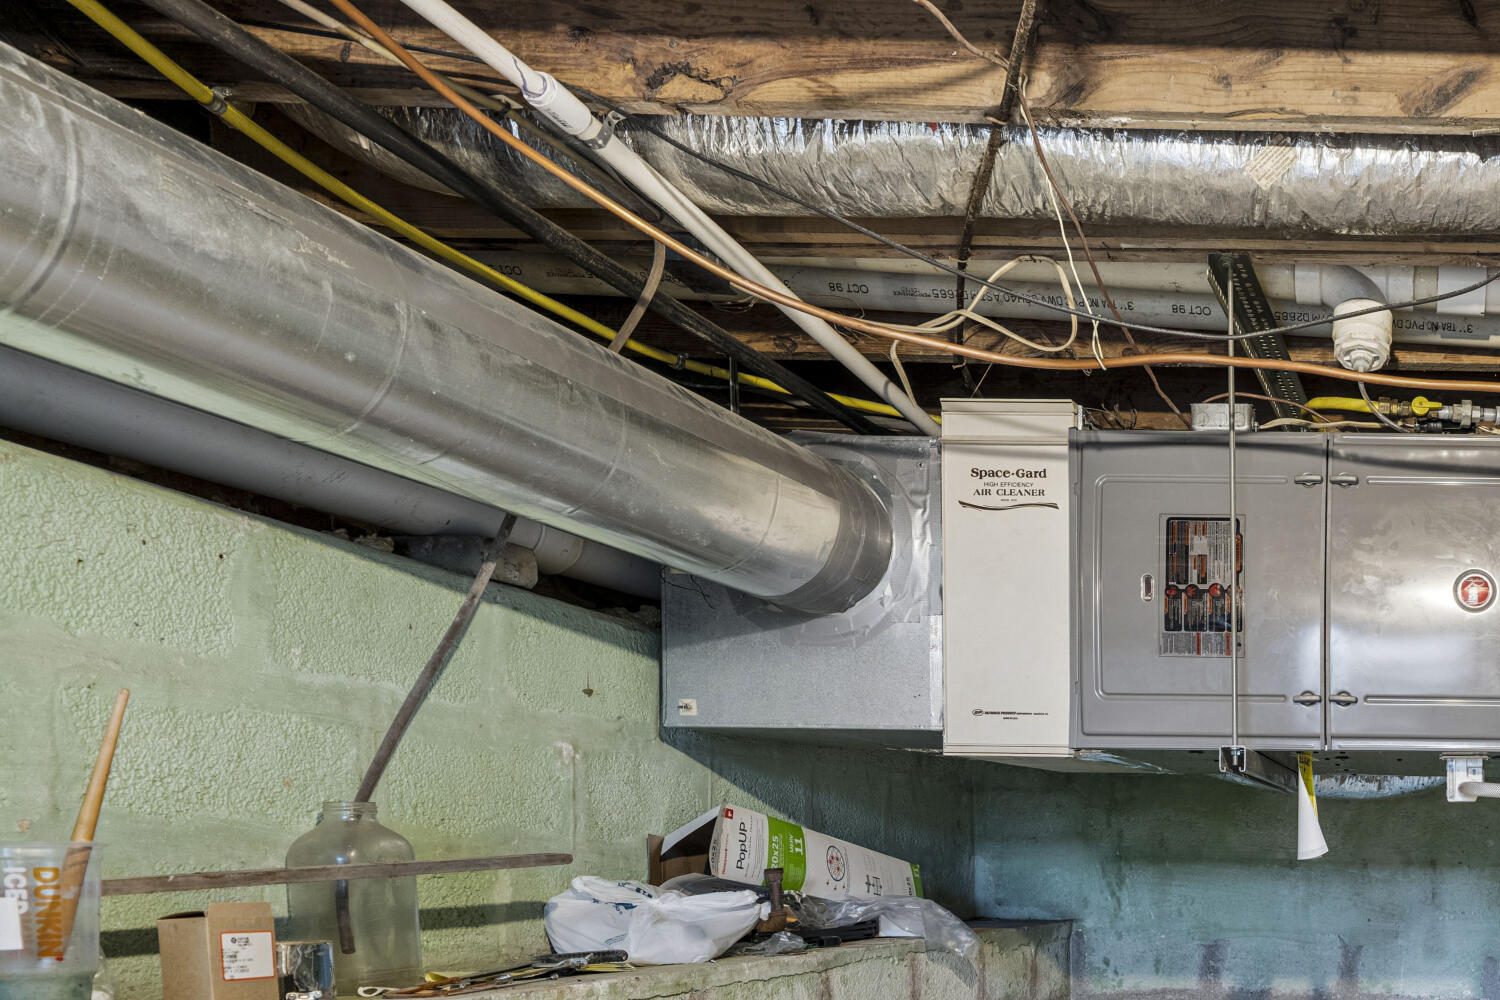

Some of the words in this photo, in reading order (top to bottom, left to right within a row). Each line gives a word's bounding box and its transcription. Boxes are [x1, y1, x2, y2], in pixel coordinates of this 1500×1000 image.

[828, 282, 842, 292] 98
[847, 283, 869, 294] OCT
[932, 289, 968, 299] D665
[1172, 304, 1186, 314] 98
[1190, 304, 1211, 316] OCT
[1405, 320, 1425, 330] PVC
[973, 488, 992, 496] AIR
[996, 488, 1045, 497] CLEANER
[735, 821, 748, 870] PopUP
[794, 838, 803, 856] 11
